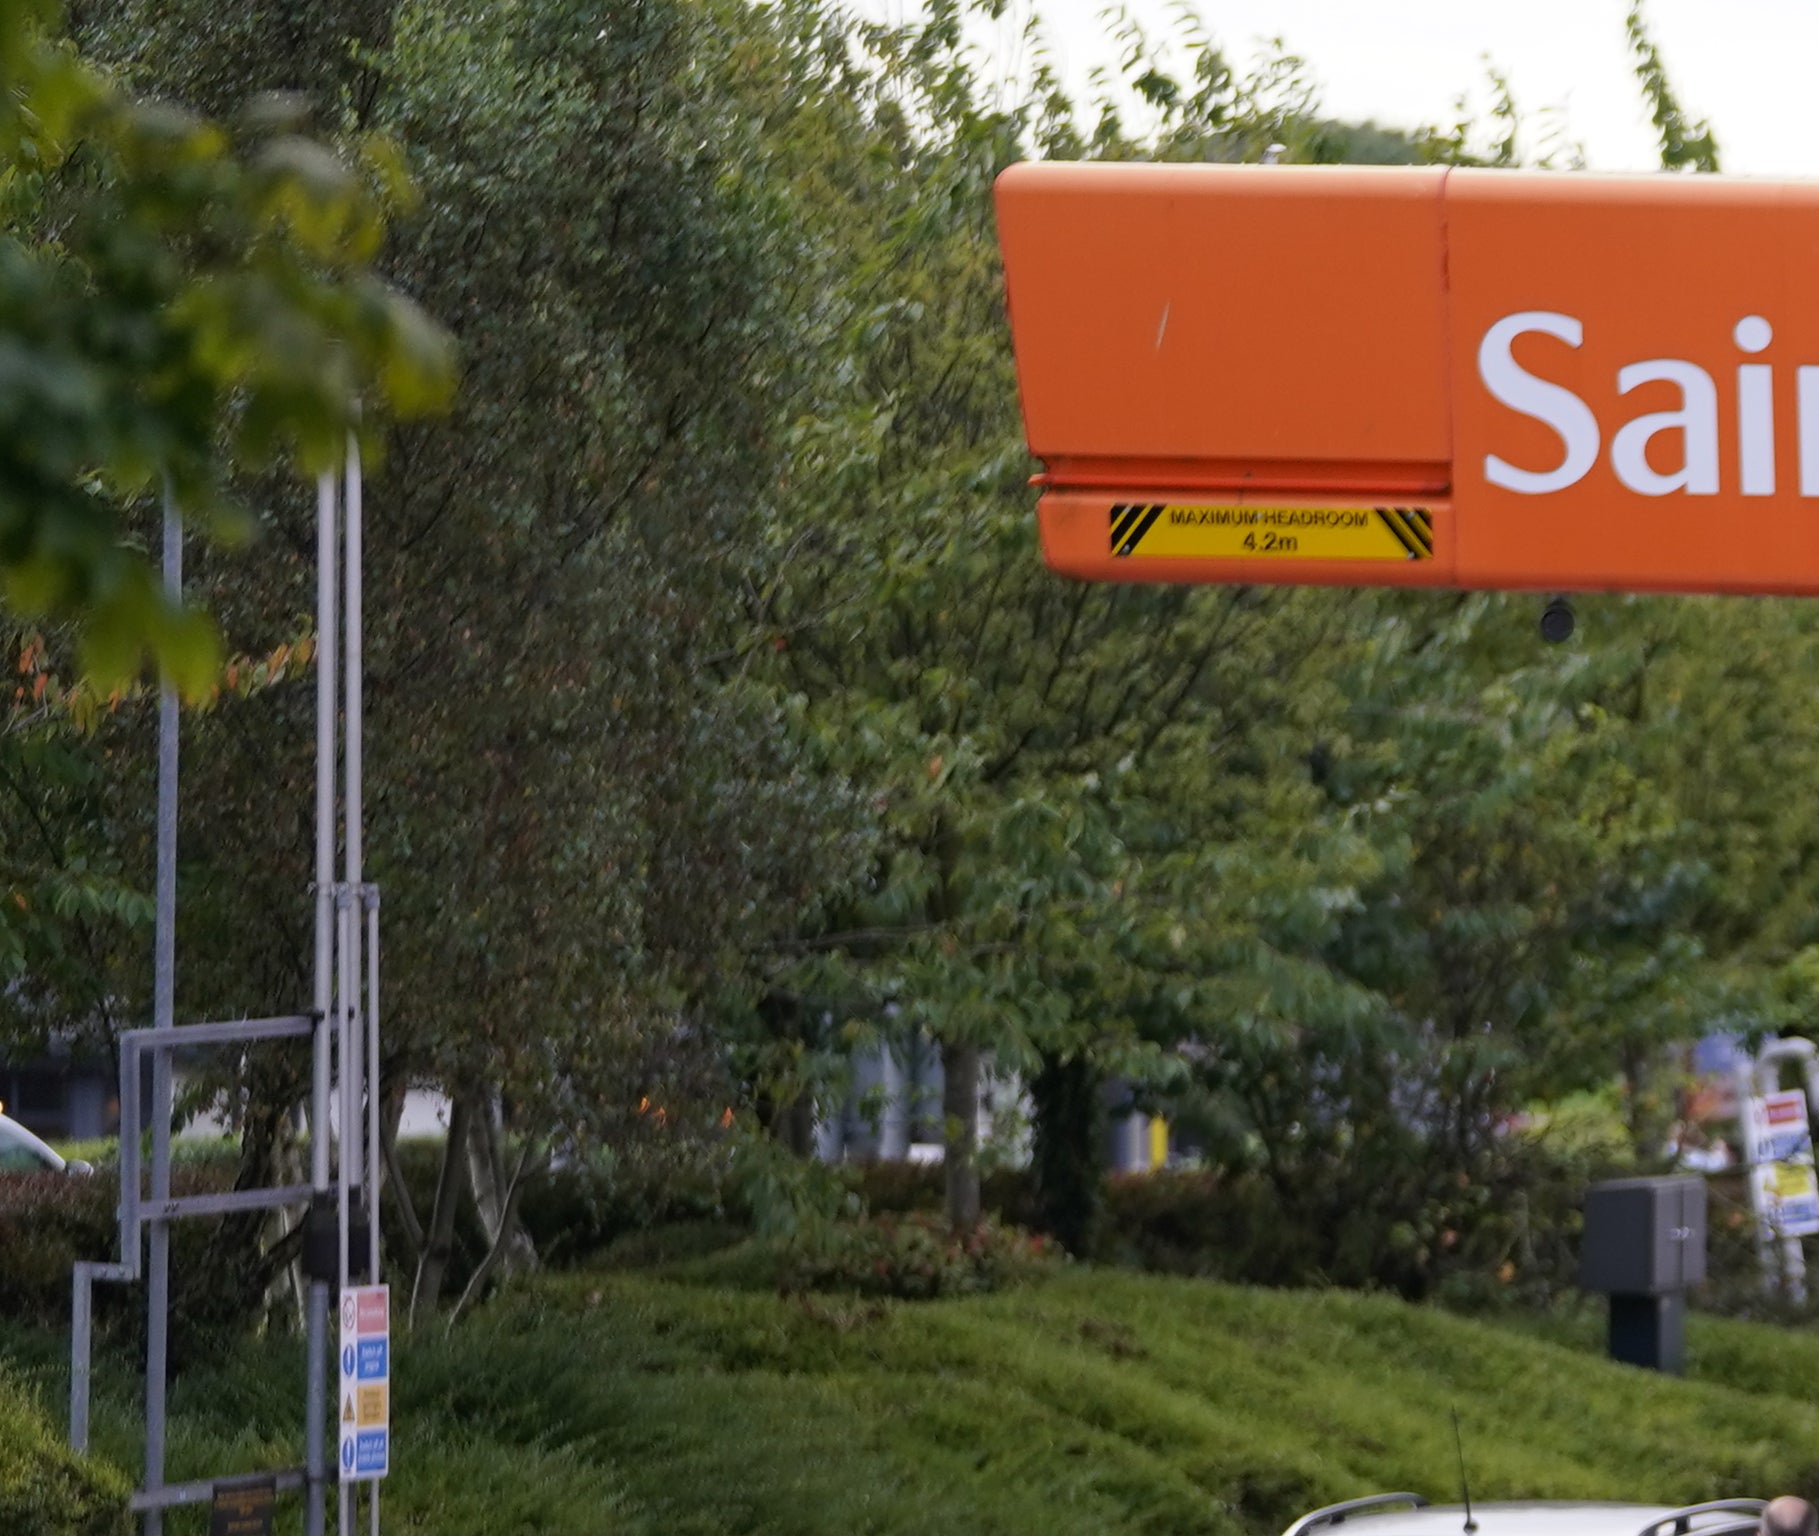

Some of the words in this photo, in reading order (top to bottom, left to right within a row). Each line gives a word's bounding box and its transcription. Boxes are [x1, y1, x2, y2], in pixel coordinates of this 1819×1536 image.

[1170, 509, 1257, 525] MAXIMUM
[1263, 510, 1369, 527] HEADROOM
[1242, 532, 1299, 551] 4.2m
